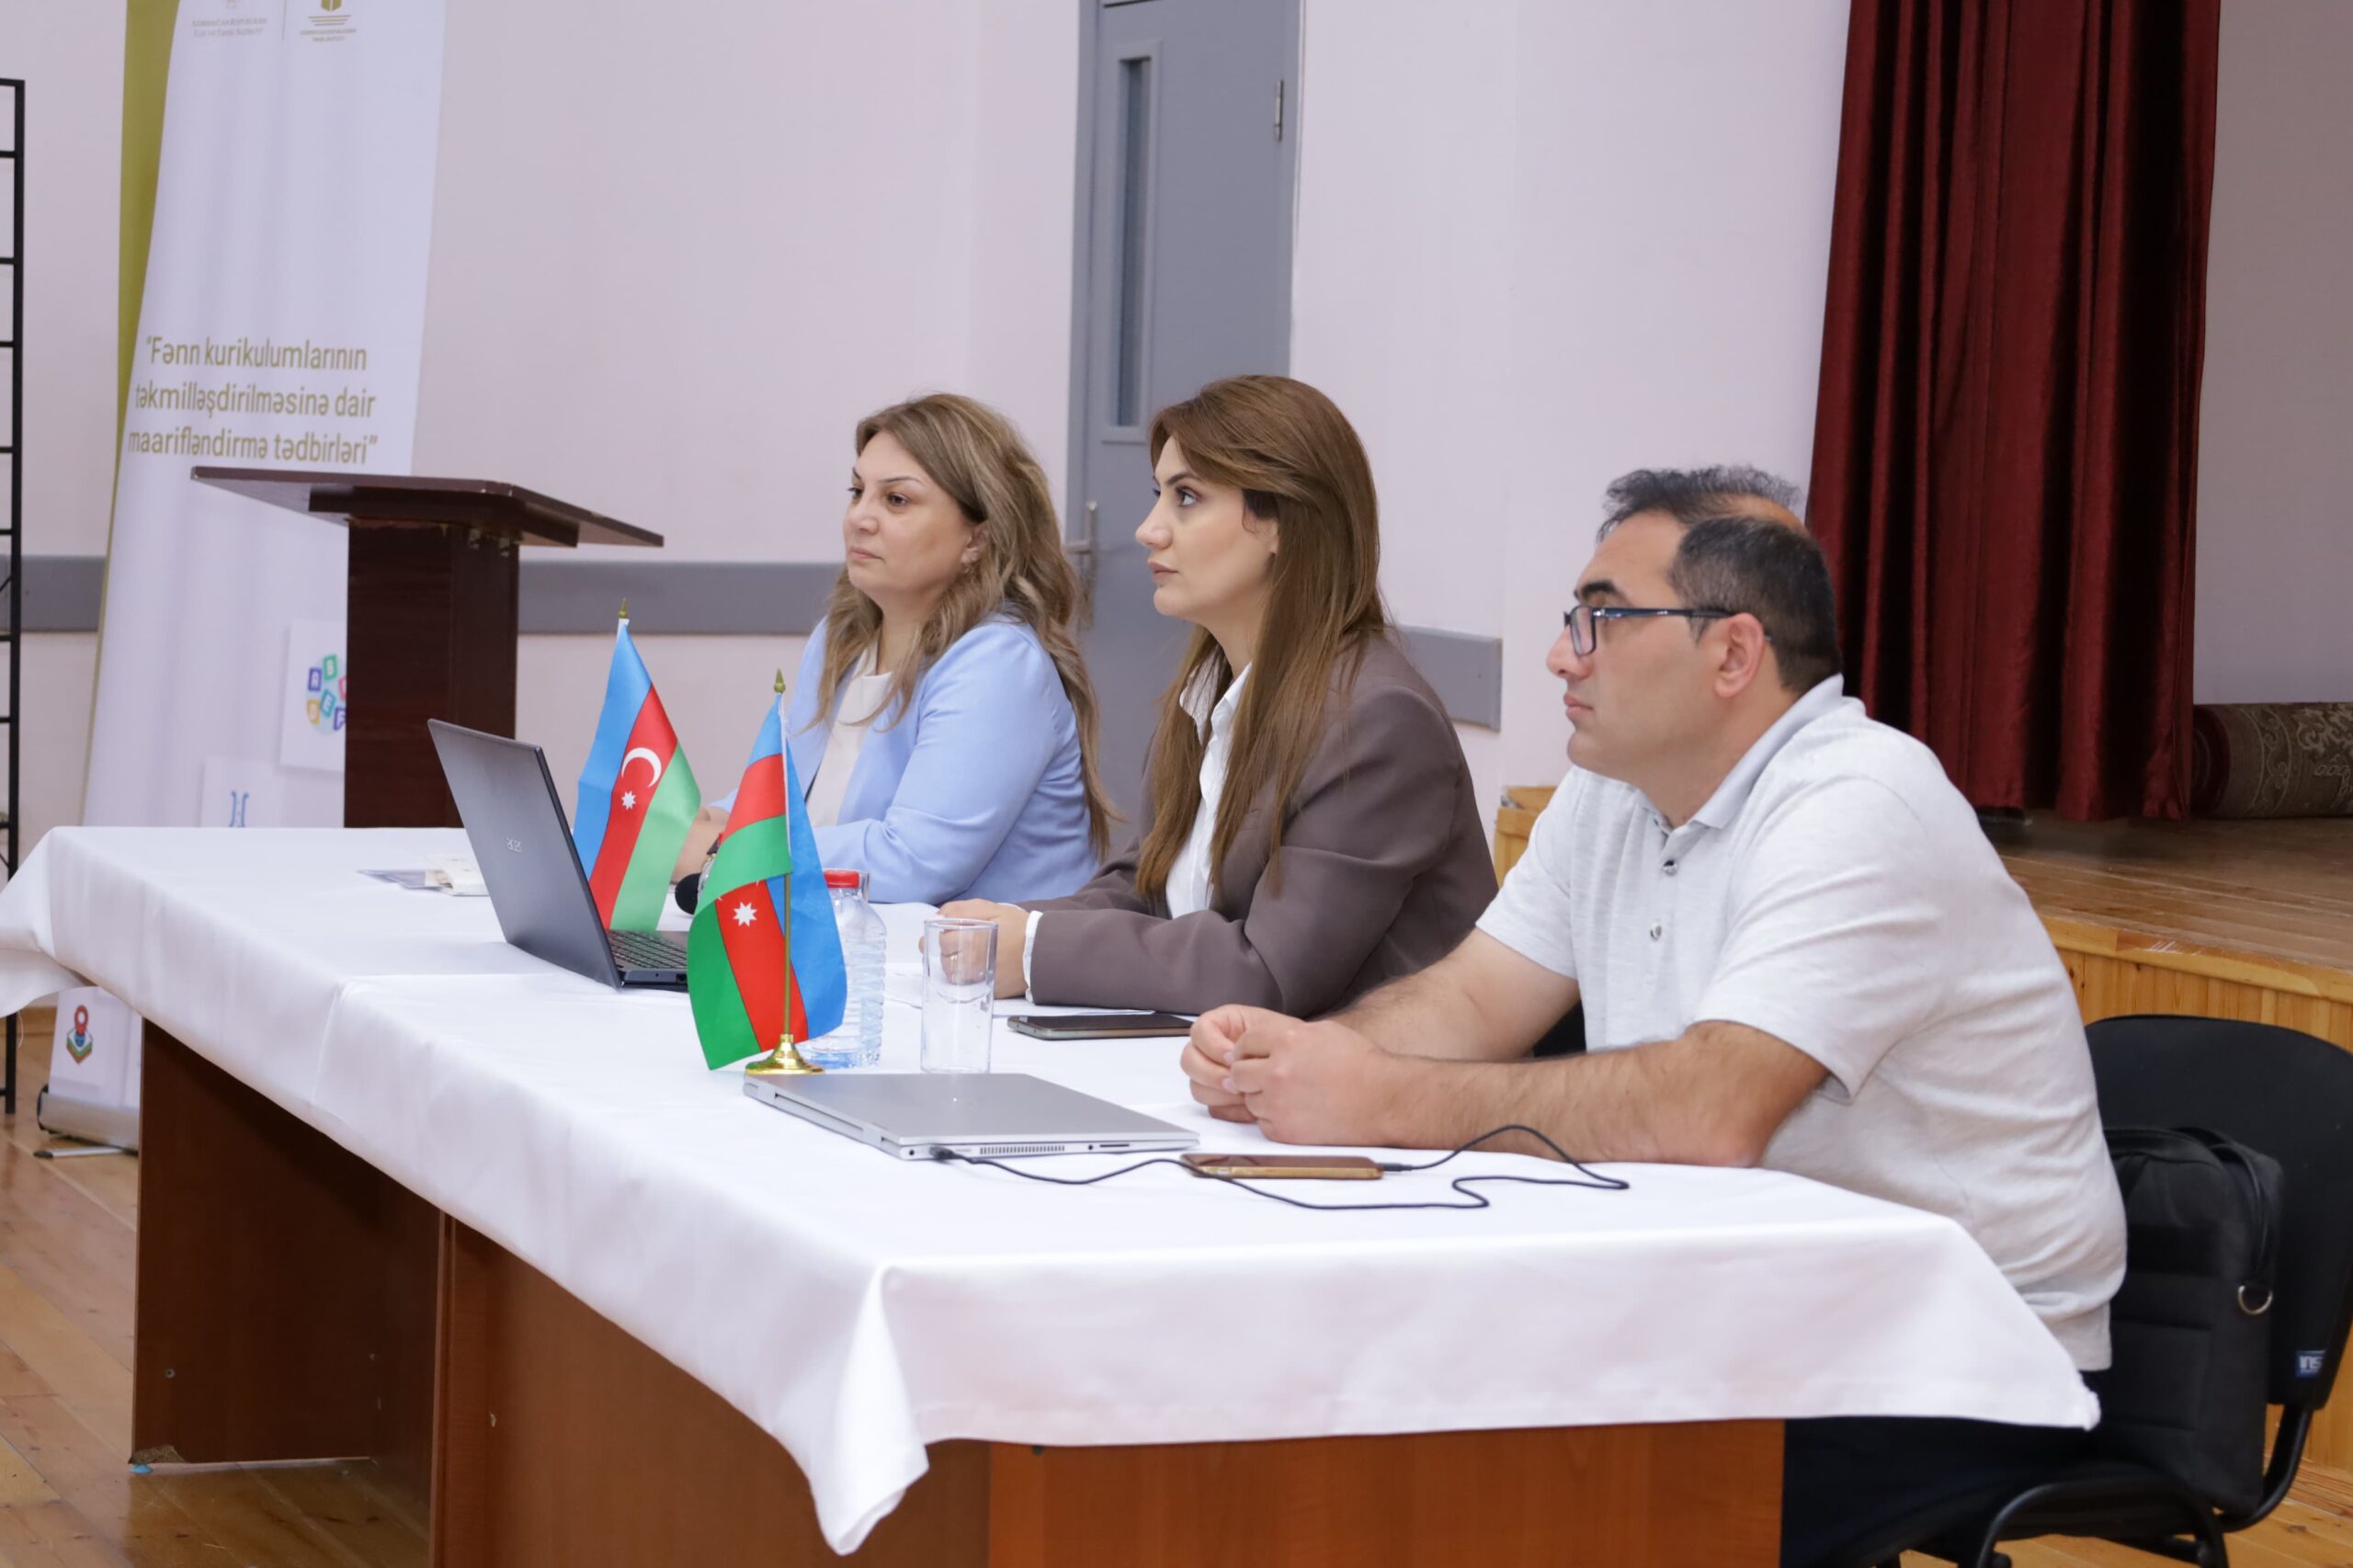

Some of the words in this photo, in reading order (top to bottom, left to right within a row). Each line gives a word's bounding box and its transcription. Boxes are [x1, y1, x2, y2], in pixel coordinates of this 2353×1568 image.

[204, 337, 367, 370] kurikulumlarının
[135, 381, 329, 418] təkmilləşdirilməsinə
[335, 386, 376, 417] dair
[128, 426, 268, 459] maarifləndirmə
